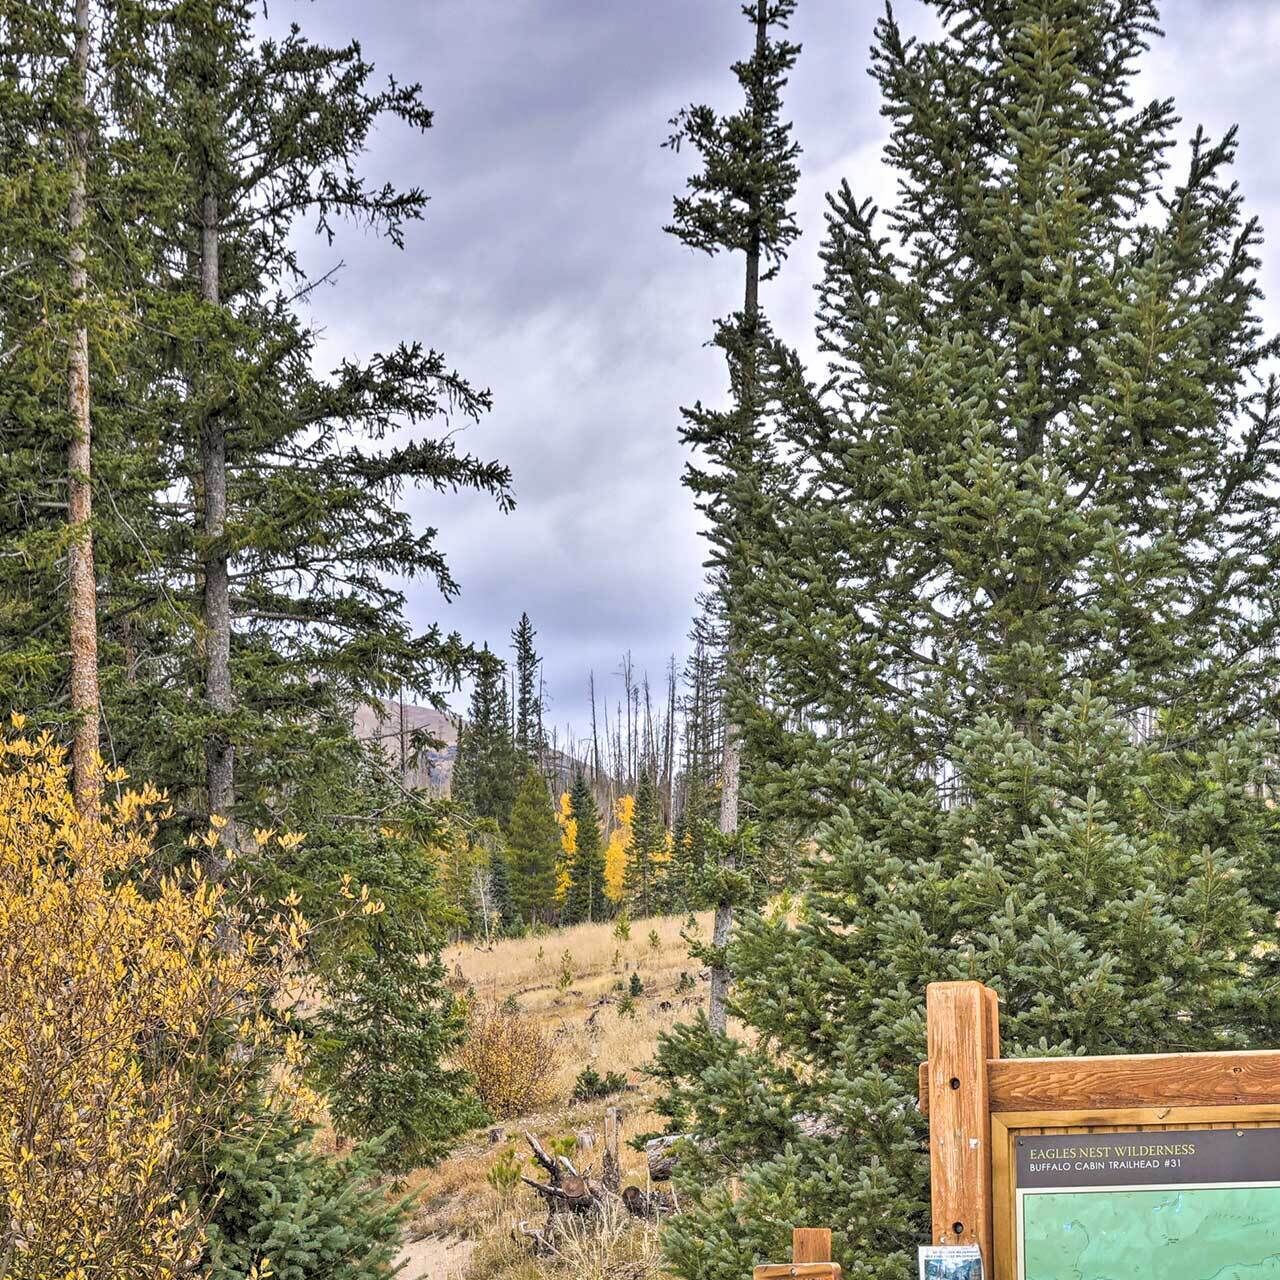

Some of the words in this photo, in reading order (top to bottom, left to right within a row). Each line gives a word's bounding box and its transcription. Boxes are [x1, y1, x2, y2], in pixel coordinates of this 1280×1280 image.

[1030, 1147, 1076, 1160] EAGLES
[1080, 1146, 1111, 1158] NEST
[1114, 1143, 1195, 1157] WILDERNESS
[1029, 1163, 1070, 1171] BUFFALO
[1074, 1162, 1104, 1170] CABIN
[1109, 1160, 1159, 1169] TRAILHEAD
[1164, 1159, 1180, 1167] #31
